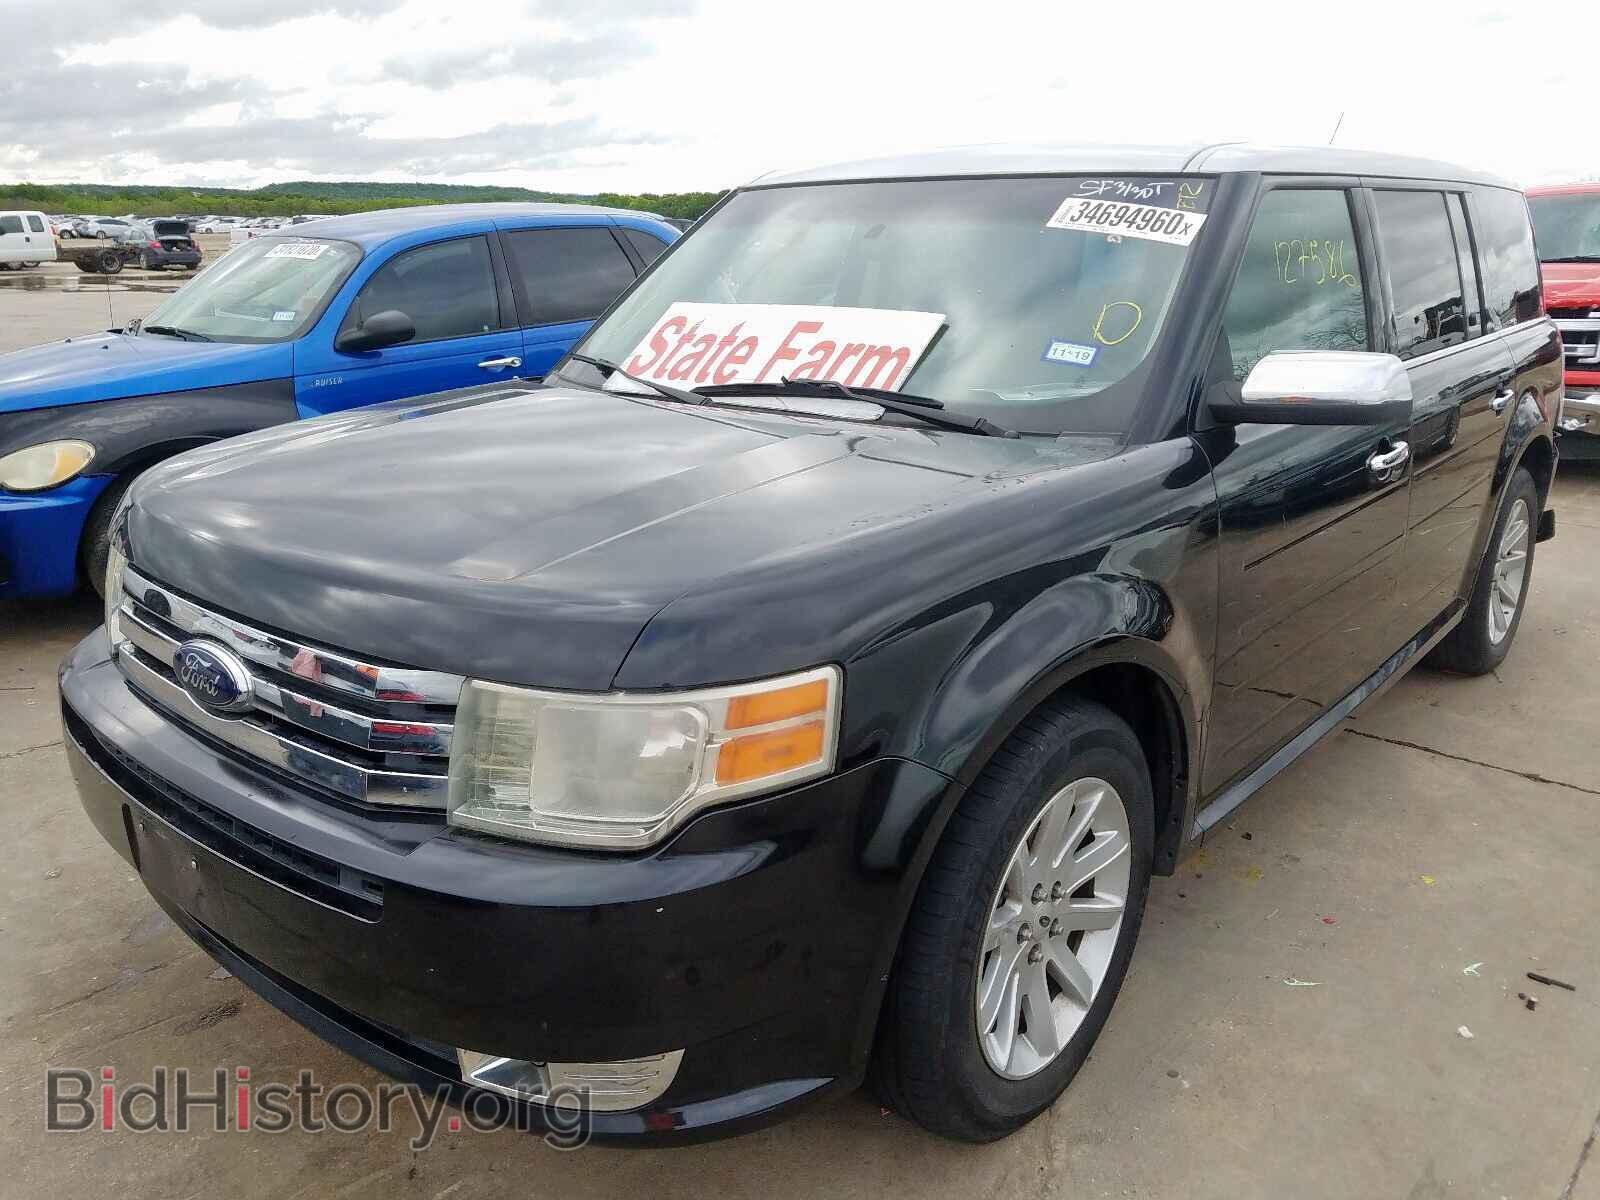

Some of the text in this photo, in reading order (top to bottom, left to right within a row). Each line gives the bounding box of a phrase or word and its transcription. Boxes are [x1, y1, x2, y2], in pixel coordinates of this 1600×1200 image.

[628, 316, 911, 392] State Farm
[181, 653, 221, 697] Ford
